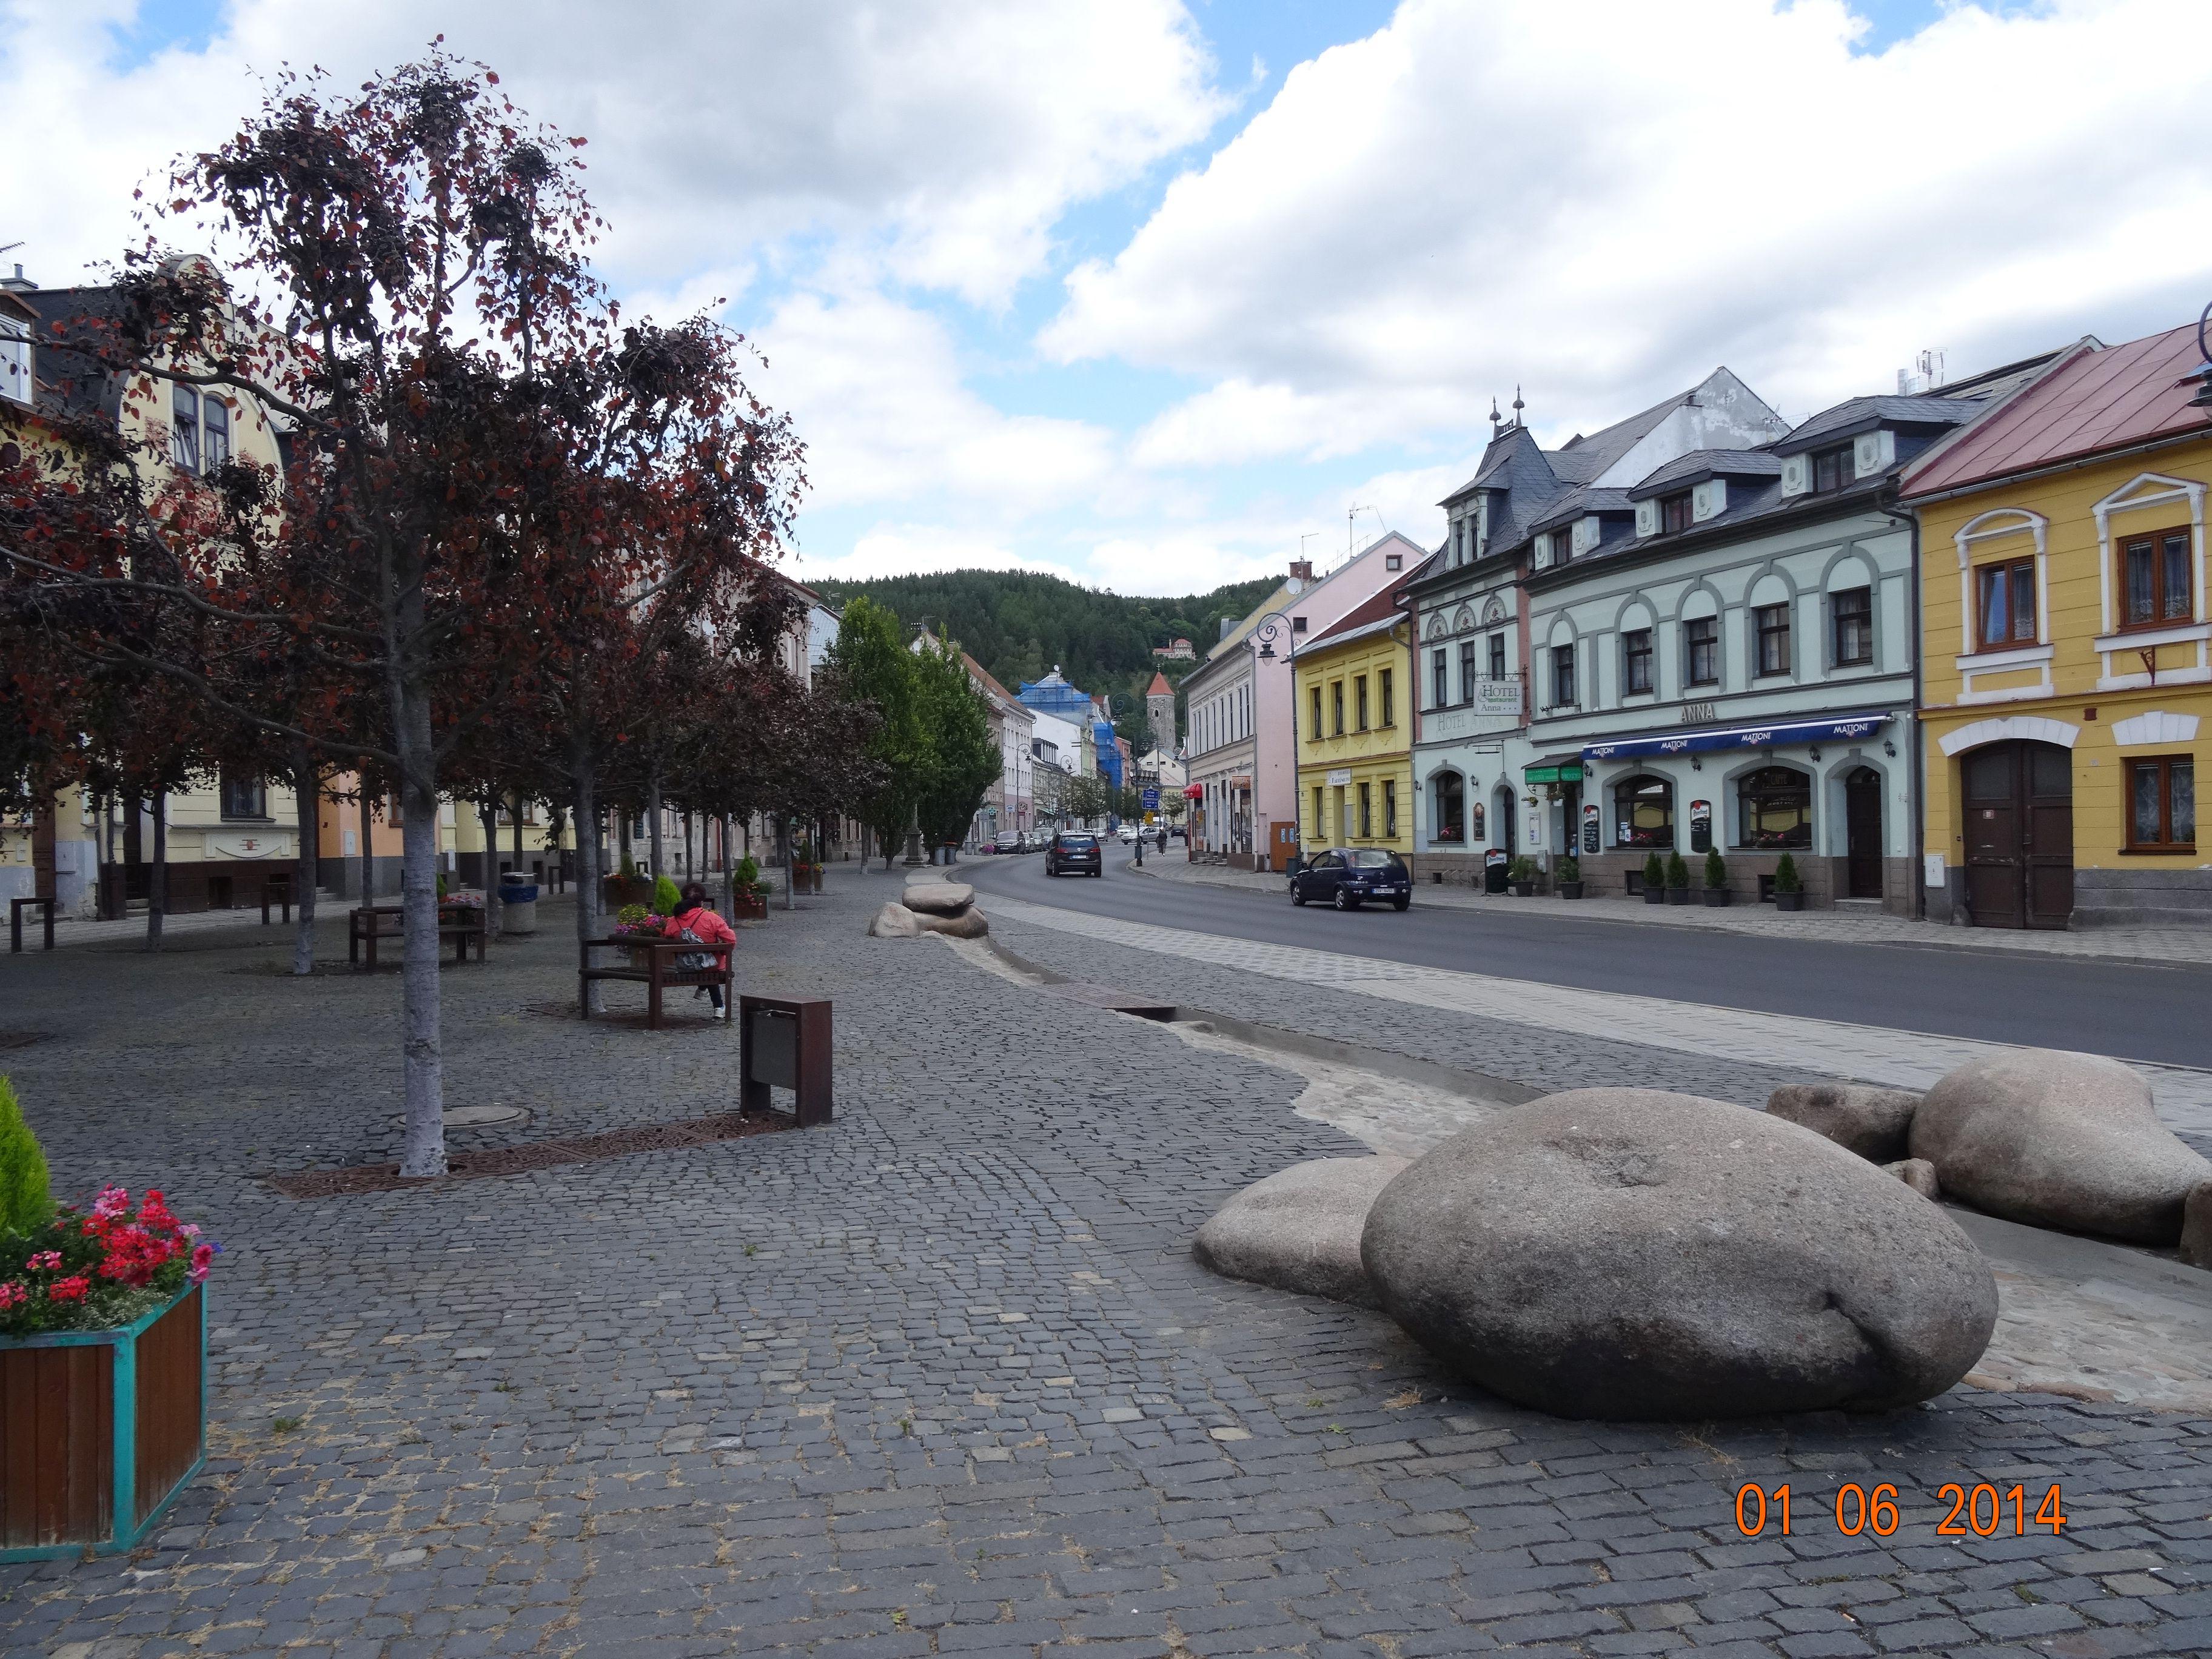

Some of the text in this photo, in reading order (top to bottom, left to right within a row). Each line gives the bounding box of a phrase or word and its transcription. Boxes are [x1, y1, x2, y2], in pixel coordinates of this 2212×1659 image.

[1483, 685, 1520, 697] HOTEL
[1680, 703, 1714, 722] ANNA
[1437, 714, 1466, 731] HOTEL
[1833, 723, 1869, 734] MATTONI
[1741, 732, 1771, 742] MATTONI
[1661, 740, 1687, 749] MATTONI
[1592, 746, 1614, 755] MATTONI
